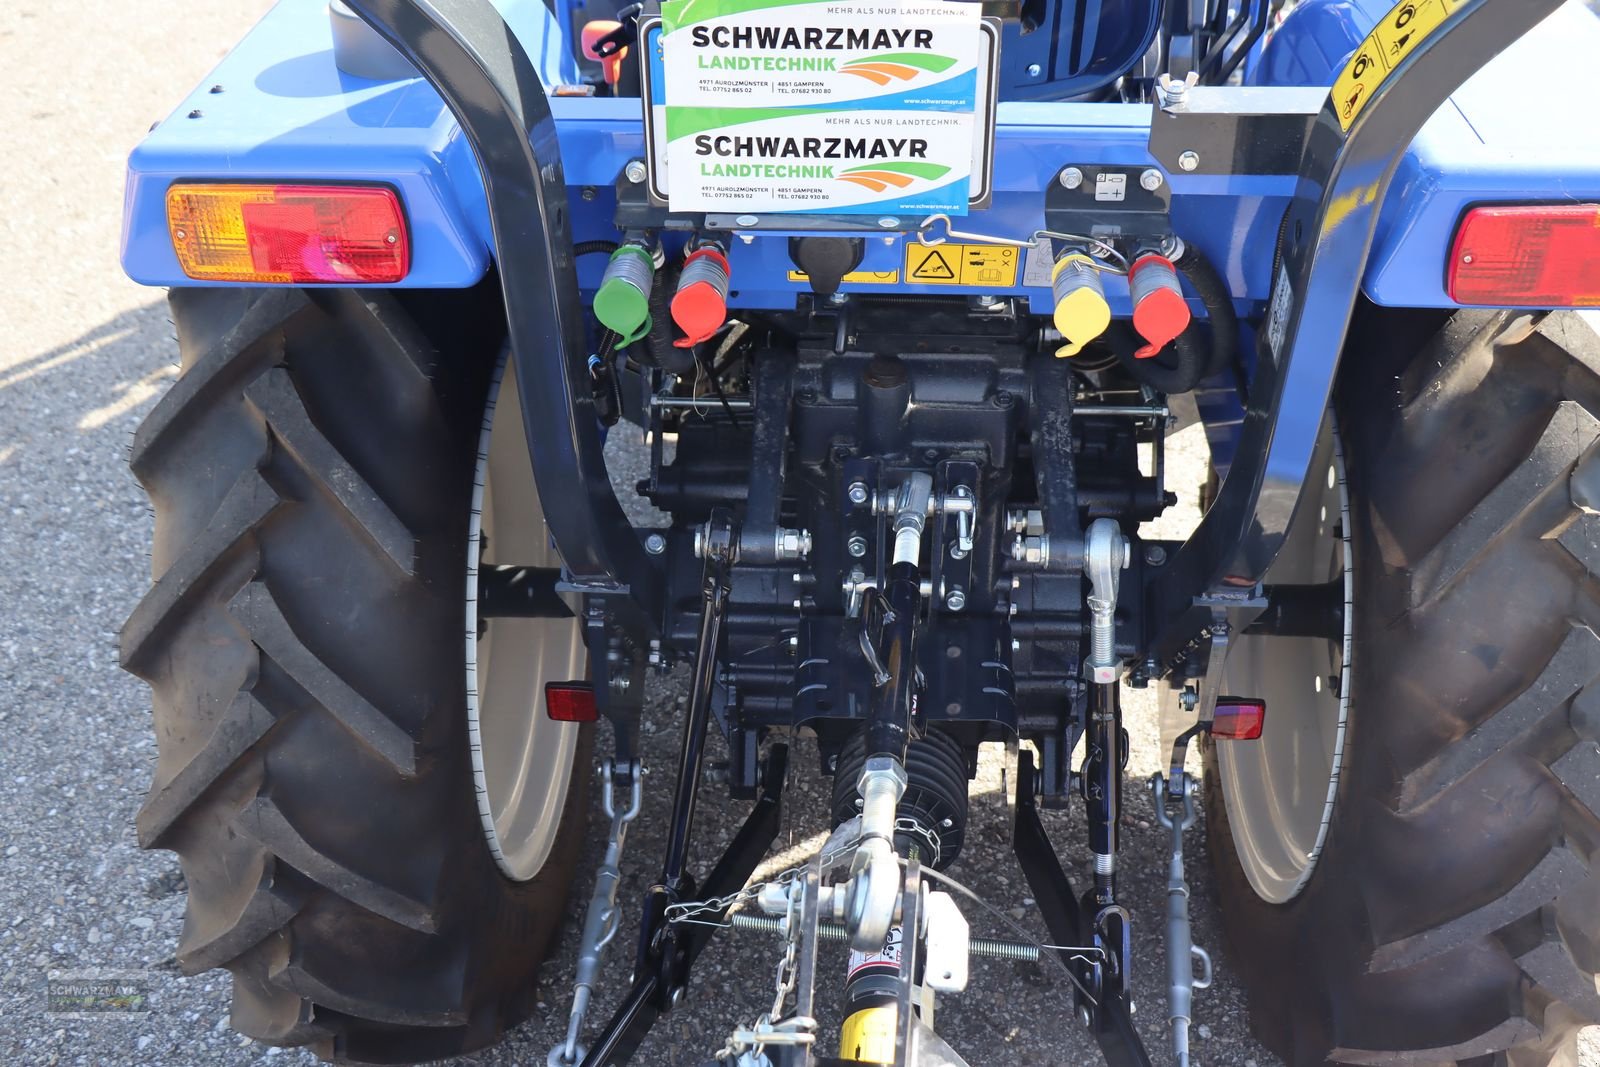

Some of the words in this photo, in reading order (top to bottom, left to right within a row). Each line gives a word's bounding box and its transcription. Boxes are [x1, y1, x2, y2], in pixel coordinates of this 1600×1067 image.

[827, 7, 853, 15] MEHR
[856, 7, 874, 15] ALS
[692, 26, 934, 50] SCHWARZMAYR
[698, 55, 837, 72] LANDTECHNIK
[695, 135, 928, 159] SCHWARZMAYR
[701, 163, 834, 179] LANDTECHNIK
